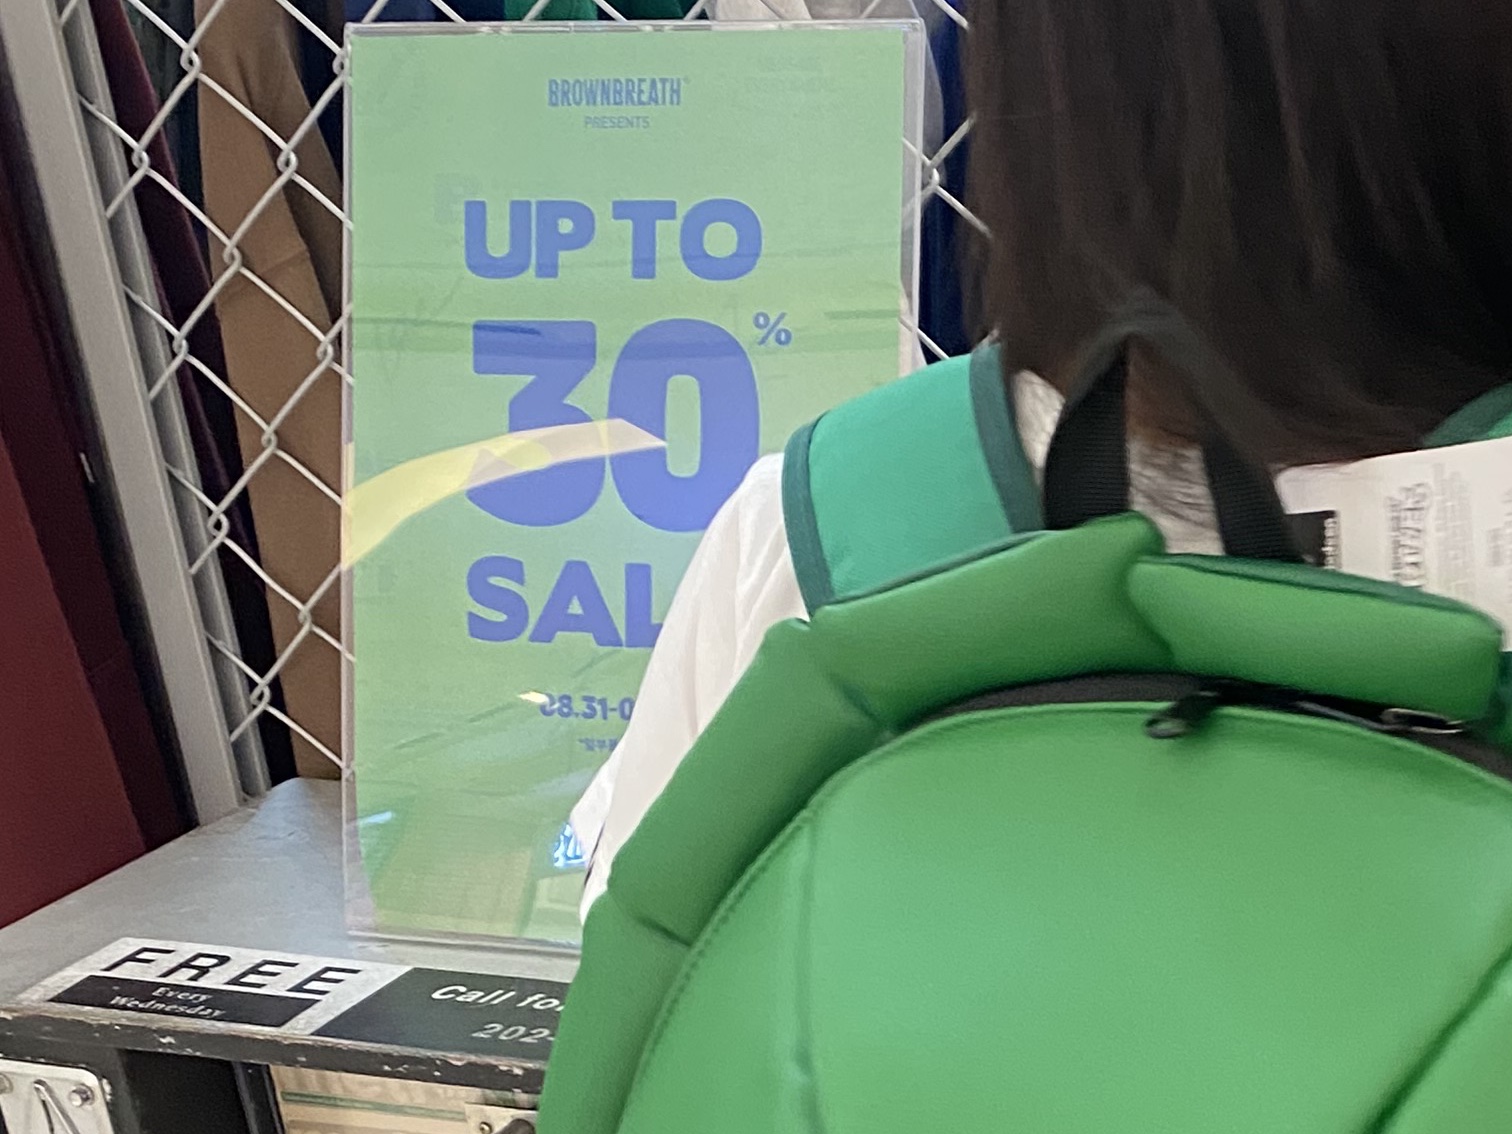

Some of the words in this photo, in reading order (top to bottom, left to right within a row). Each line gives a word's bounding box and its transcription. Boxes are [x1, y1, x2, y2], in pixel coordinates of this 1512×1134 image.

[547, 77, 682, 107] BROWNBREATH
[584, 116, 651, 129] PRESENTS
[464, 199, 596, 280] UP
[611, 198, 762, 281] TO
[466, 555, 668, 648] SAL
[100, 946, 363, 996] FREE
[151, 986, 213, 1002] Every
[431, 985, 517, 1005] Call
[109, 996, 226, 1019] Wednesday
